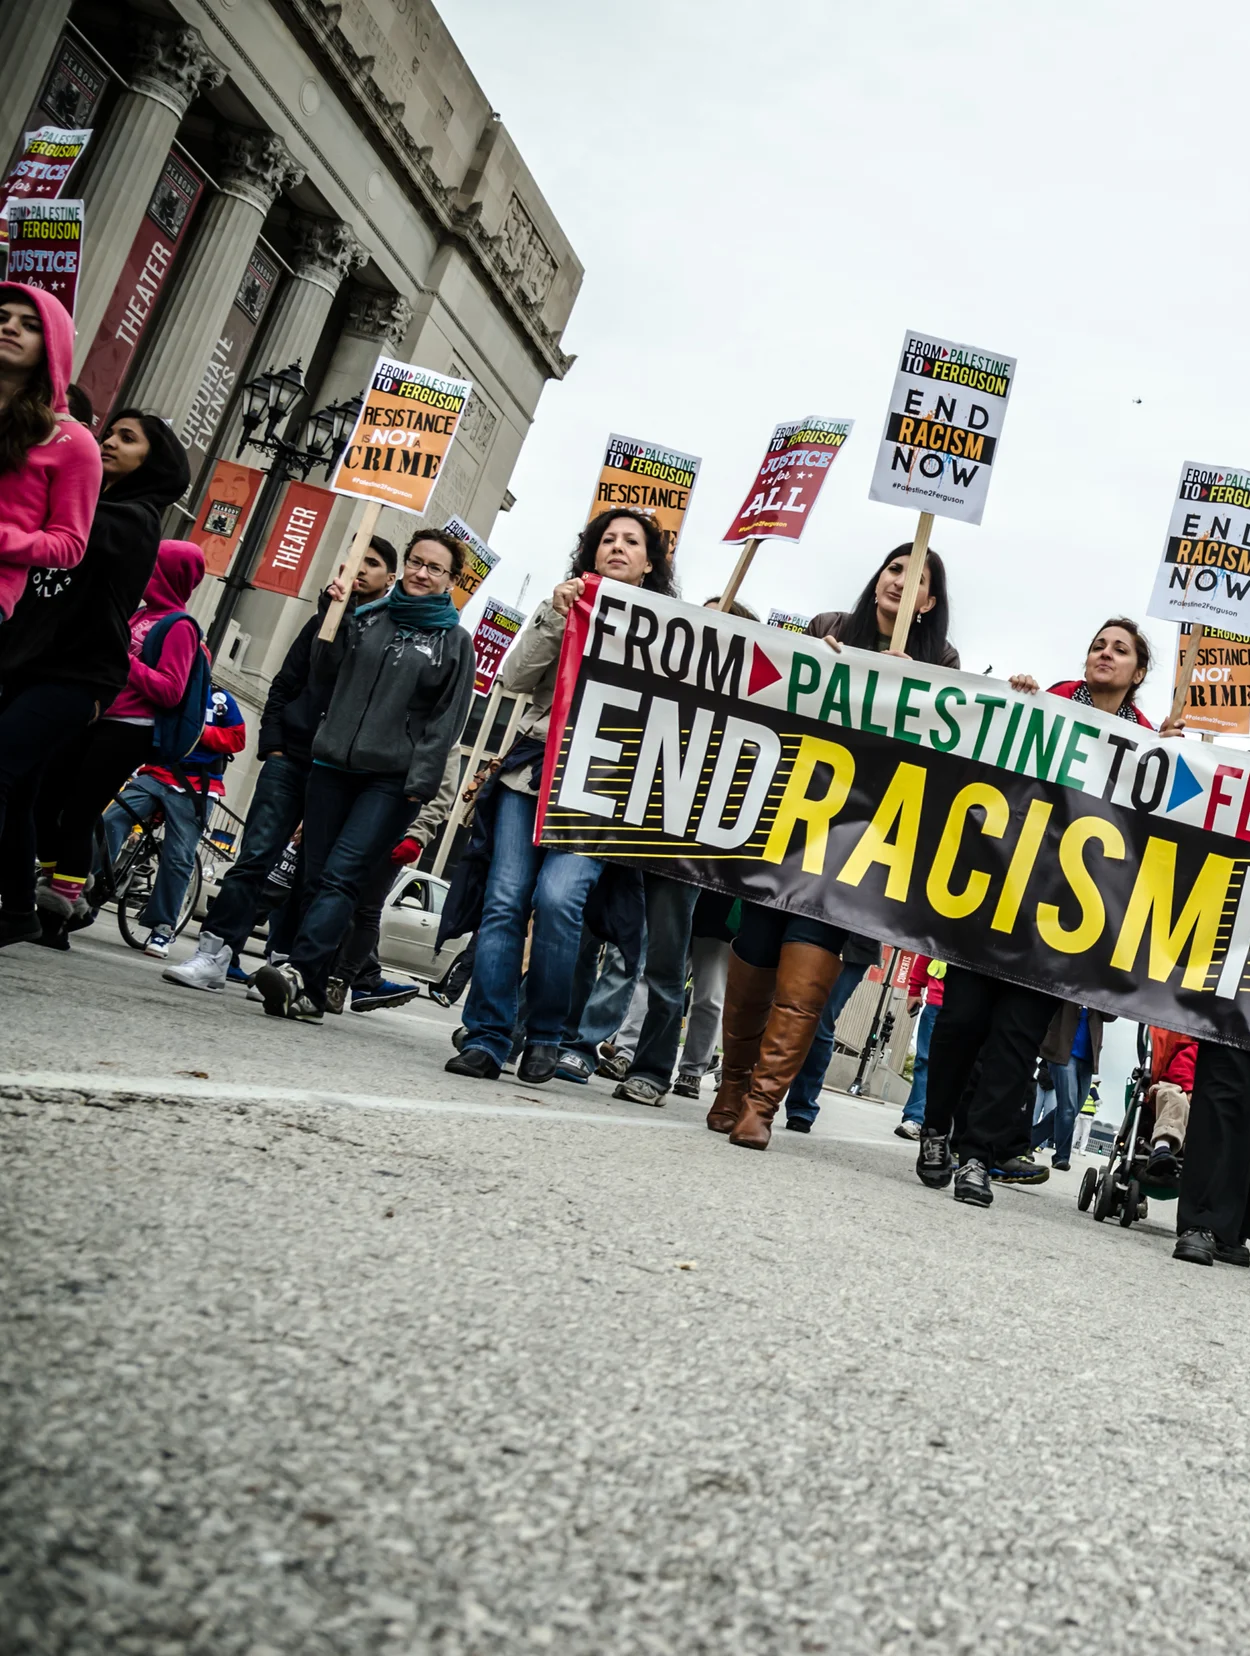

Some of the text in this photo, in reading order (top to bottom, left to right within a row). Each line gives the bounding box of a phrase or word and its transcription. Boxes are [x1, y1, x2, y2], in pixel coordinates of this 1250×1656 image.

[63, 52, 99, 92] PEABODY
[27, 141, 82, 158] FERGUSON
[42, 130, 87, 145] PALESTINE
[10, 160, 70, 180] USTICE
[166, 164, 195, 197] PEABODY
[8, 179, 31, 193] for
[31, 206, 80, 221] PALESTINE
[23, 221, 80, 239] FERGUSON
[9, 249, 77, 273] JUSTICE
[115, 241, 172, 347] THEATER
[907, 338, 1011, 377] FROM PALESTINE
[379, 363, 468, 397] FROM PALESTINE
[905, 354, 1007, 396] TO FERGUSON
[376, 375, 463, 413] TO FERGUSON
[194, 366, 236, 453] EVENTS
[362, 406, 457, 436] RESISTANCE
[903, 388, 990, 430] END
[361, 428, 421, 448] IS NOT A
[770, 430, 846, 452] TO FERGUSON
[775, 425, 799, 439] FROM
[898, 416, 985, 461] RACISM
[343, 445, 442, 480] CRIME
[608, 451, 694, 488] TO FERGUSON
[610, 439, 697, 473] FROM PALESTINE
[760, 449, 834, 476] JUSTICE
[891, 446, 980, 488] NOW
[771, 470, 792, 486] for
[1185, 468, 1219, 485] FROM
[597, 482, 688, 511] RESISTANCE
[740, 486, 807, 519] ALL
[892, 481, 965, 505] #Palestine2Ferguson
[1183, 482, 1202, 500] TO
[213, 504, 239, 515] PEABODY
[272, 506, 318, 571] THEATER
[448, 520, 467, 541] FROM
[484, 608, 521, 633] TO FERGUSON
[1168, 599, 1239, 618] #Palestine2Ferguson
[477, 623, 513, 649] JUSTICE
[475, 651, 495, 678] LL
[1191, 667, 1234, 683] NOT A
[590, 593, 748, 701] FROM
[787, 650, 1102, 794] PALESTINE
[1104, 732, 1170, 814] TO
[1185, 714, 1238, 727] #Palestine2Ferguson
[556, 679, 783, 851] END
[761, 733, 1236, 995] RACISM
[896, 955, 912, 984] CONCERTS
